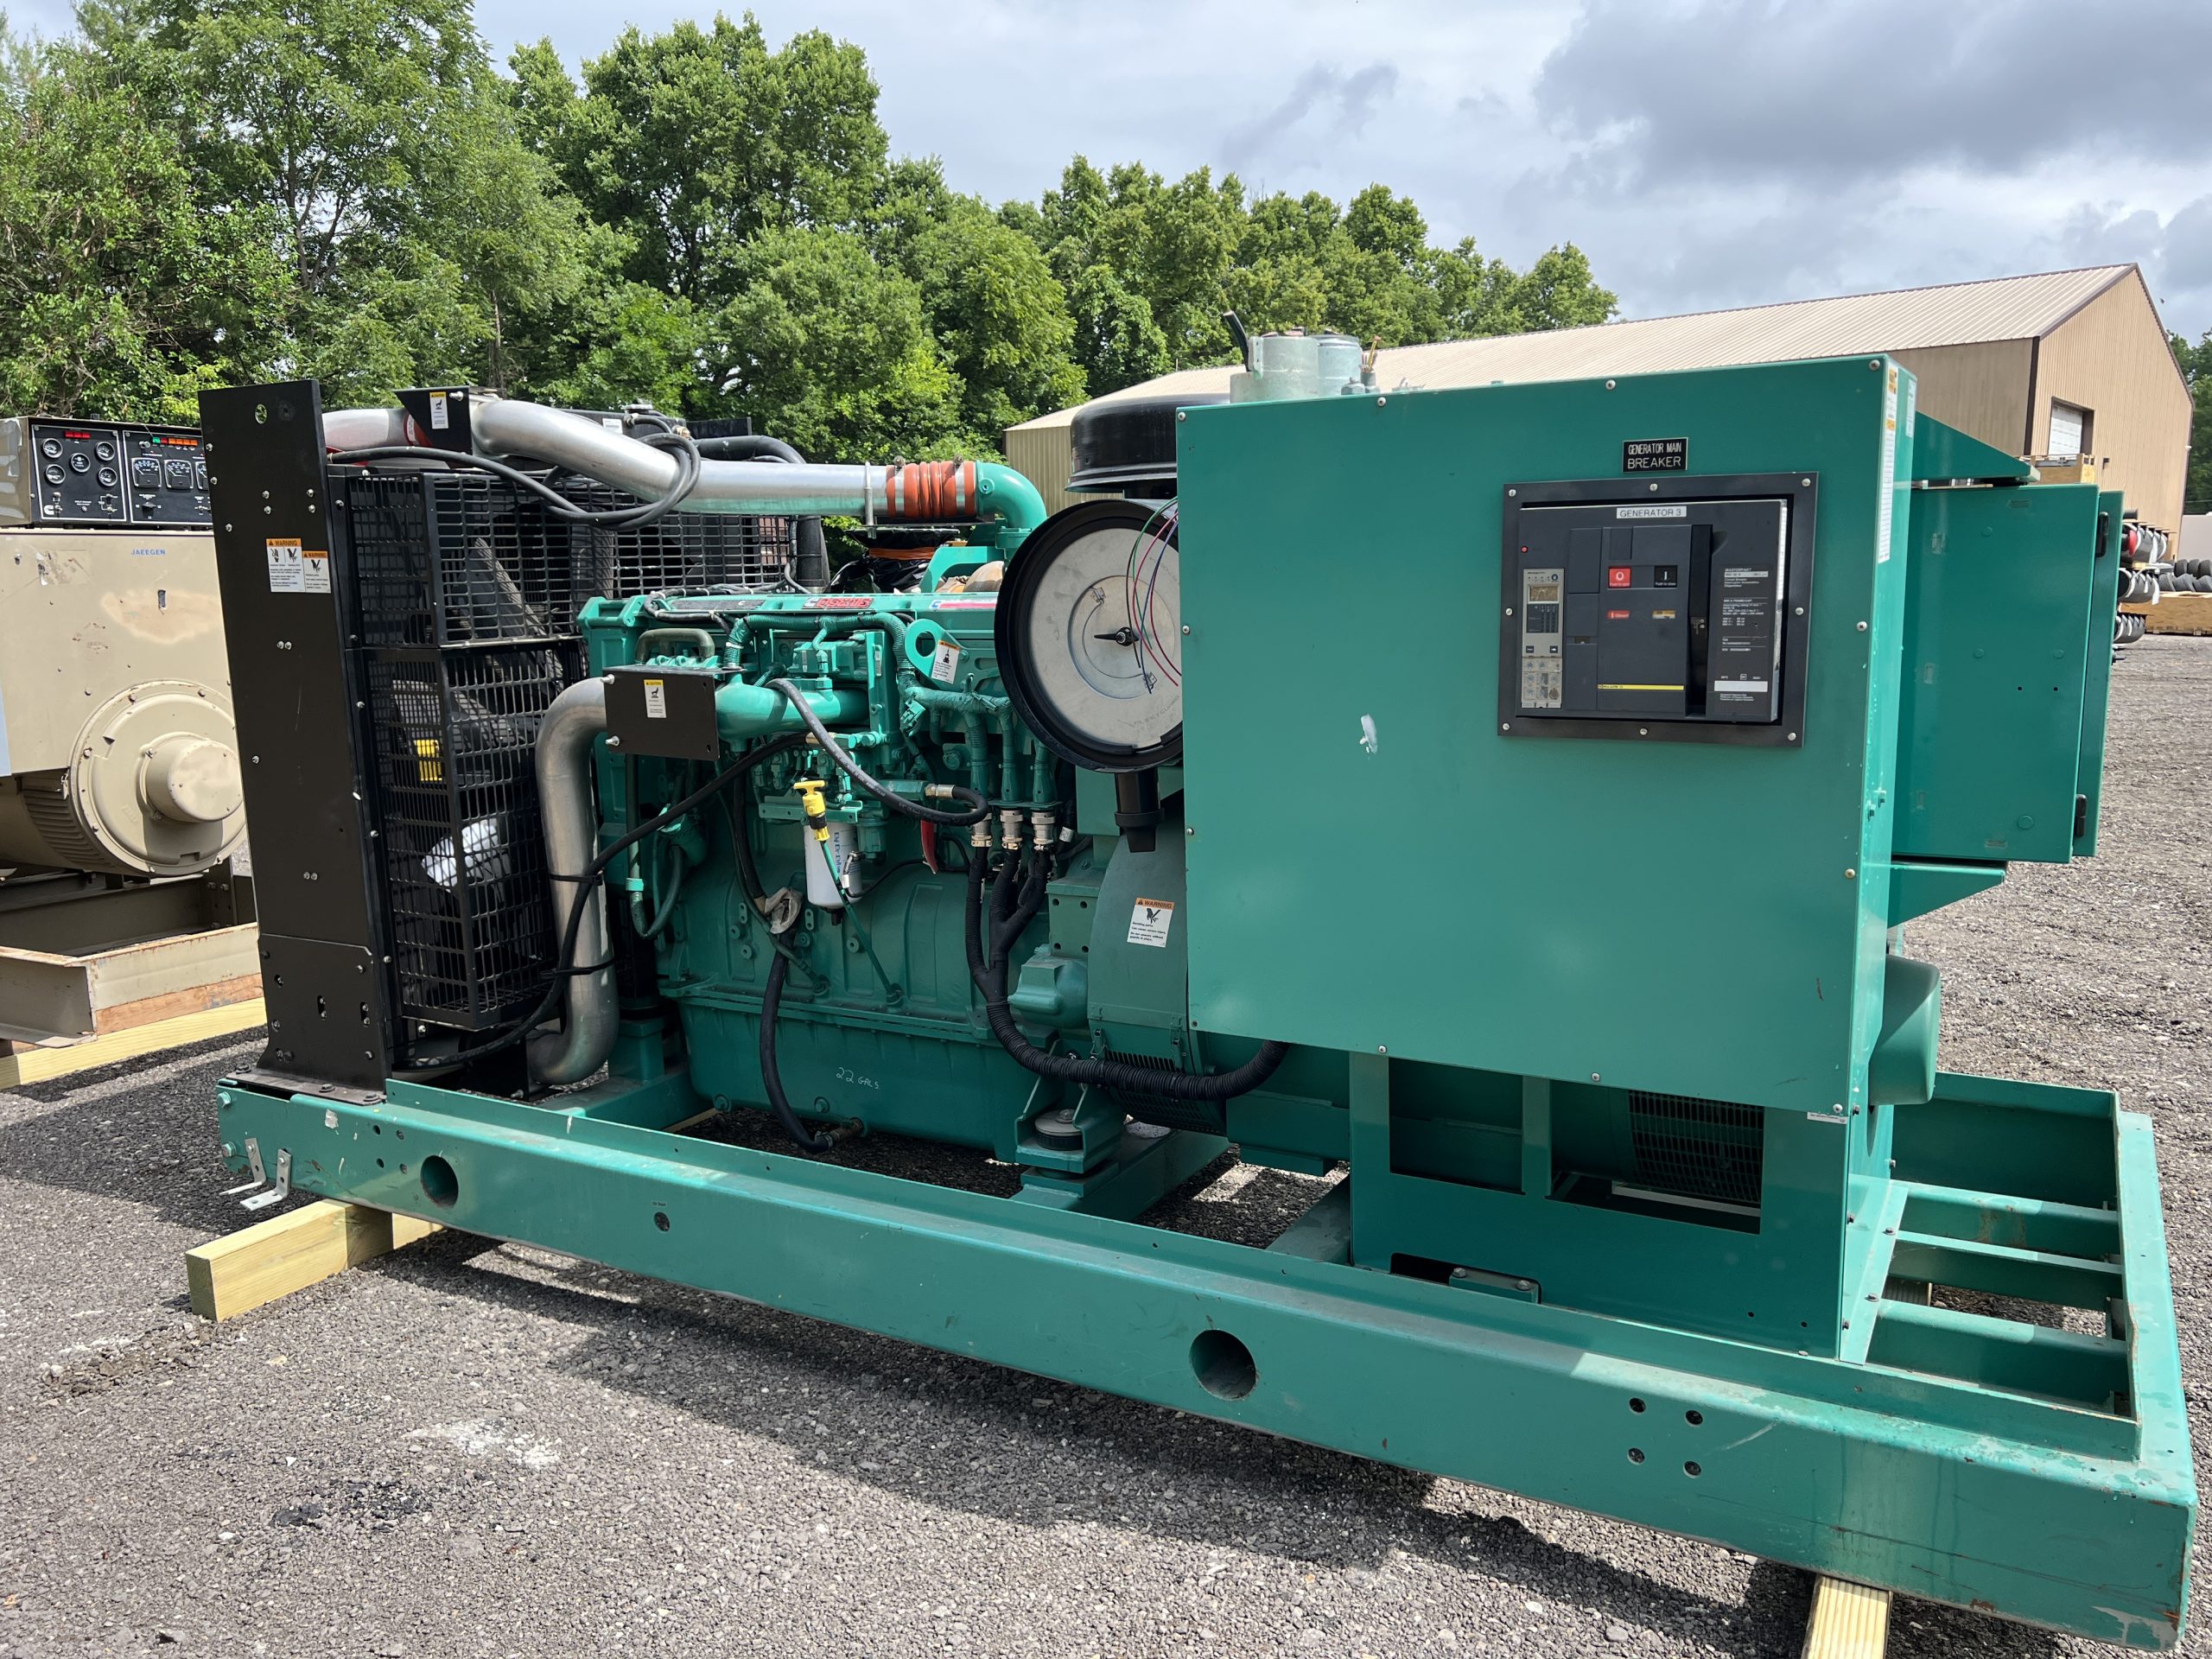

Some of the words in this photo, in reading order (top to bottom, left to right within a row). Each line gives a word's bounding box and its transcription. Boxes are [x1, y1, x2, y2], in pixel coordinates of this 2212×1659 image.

[1628, 442, 1664, 455] GENERATOR
[1666, 442, 1682, 453] MAIN
[1627, 455, 1681, 469] BREAKER
[1619, 508, 1674, 518] GENERATOR
[836, 1066, 855, 1084] 22
